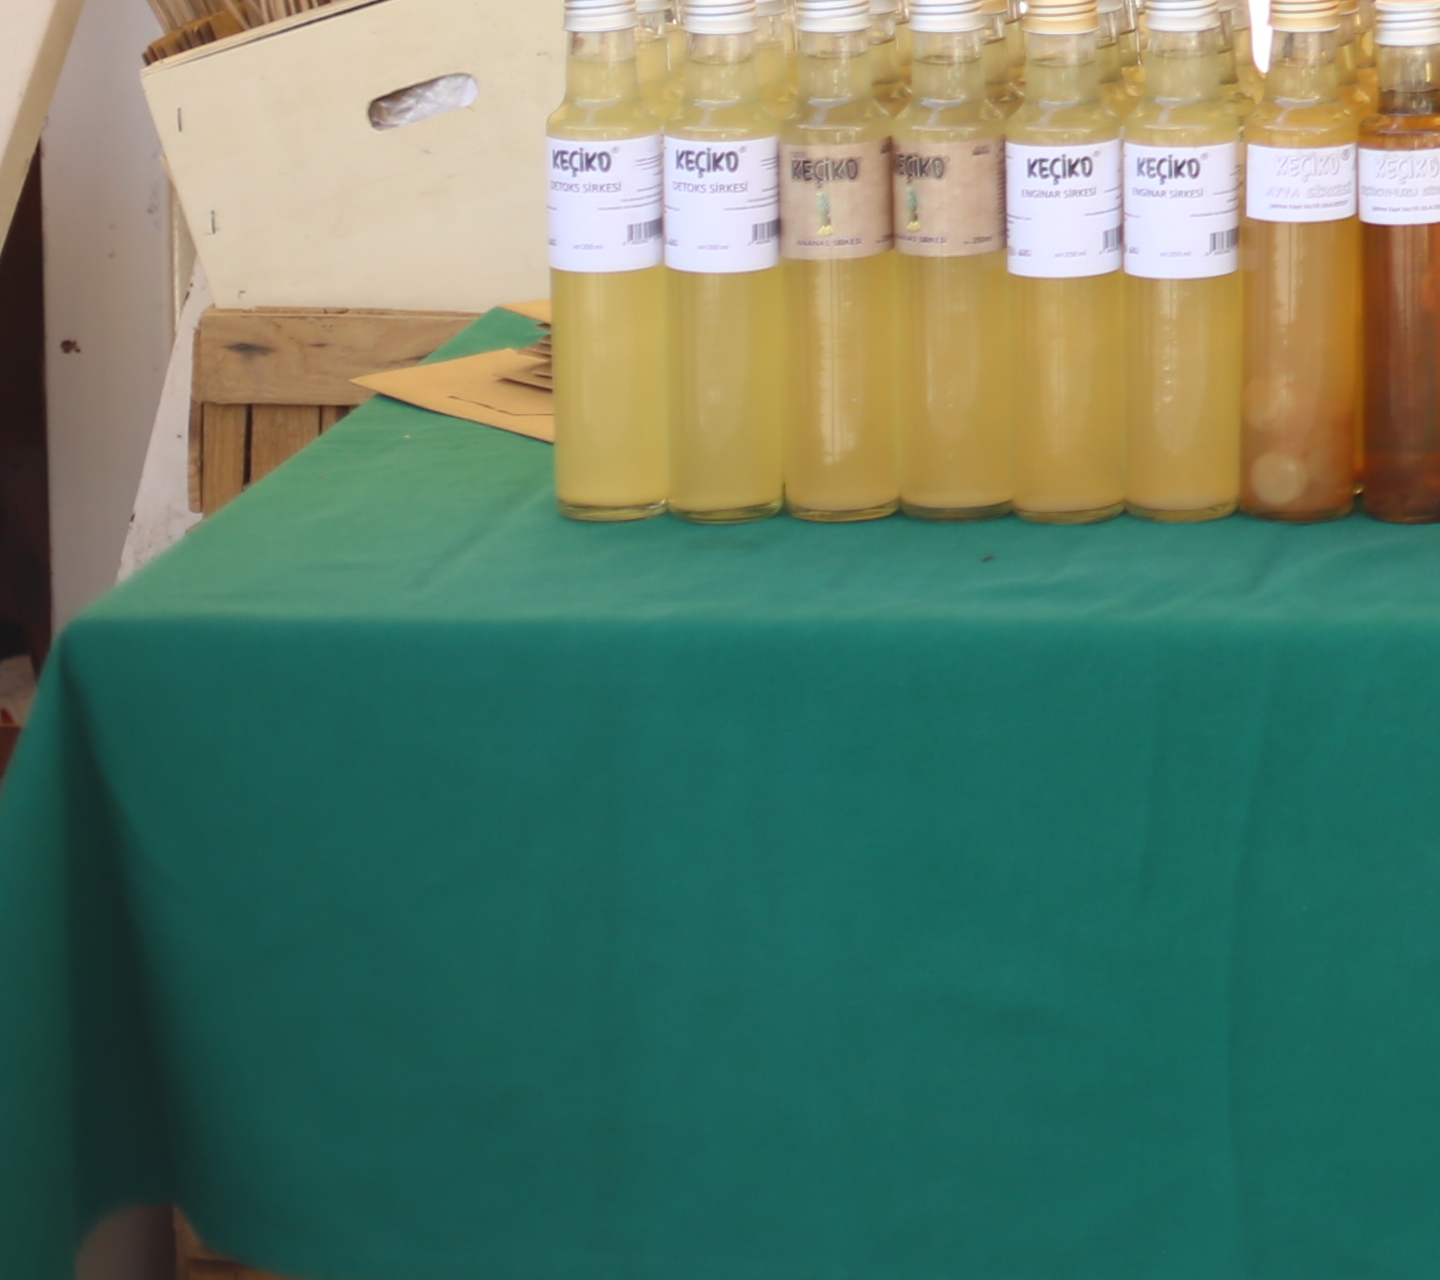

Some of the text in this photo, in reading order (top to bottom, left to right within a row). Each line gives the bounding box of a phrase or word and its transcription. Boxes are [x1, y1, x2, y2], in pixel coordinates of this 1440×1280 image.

[552, 146, 612, 178] KEÇİKO
[675, 146, 739, 179] KEÇİKO
[792, 157, 859, 189] KEÇİKO
[1027, 153, 1094, 185] KEÇİKO
[1136, 153, 1200, 185] KEÇİKO
[582, 180, 622, 194] SİRKESİ
[673, 180, 748, 194] DETOKS SİRKESİ
